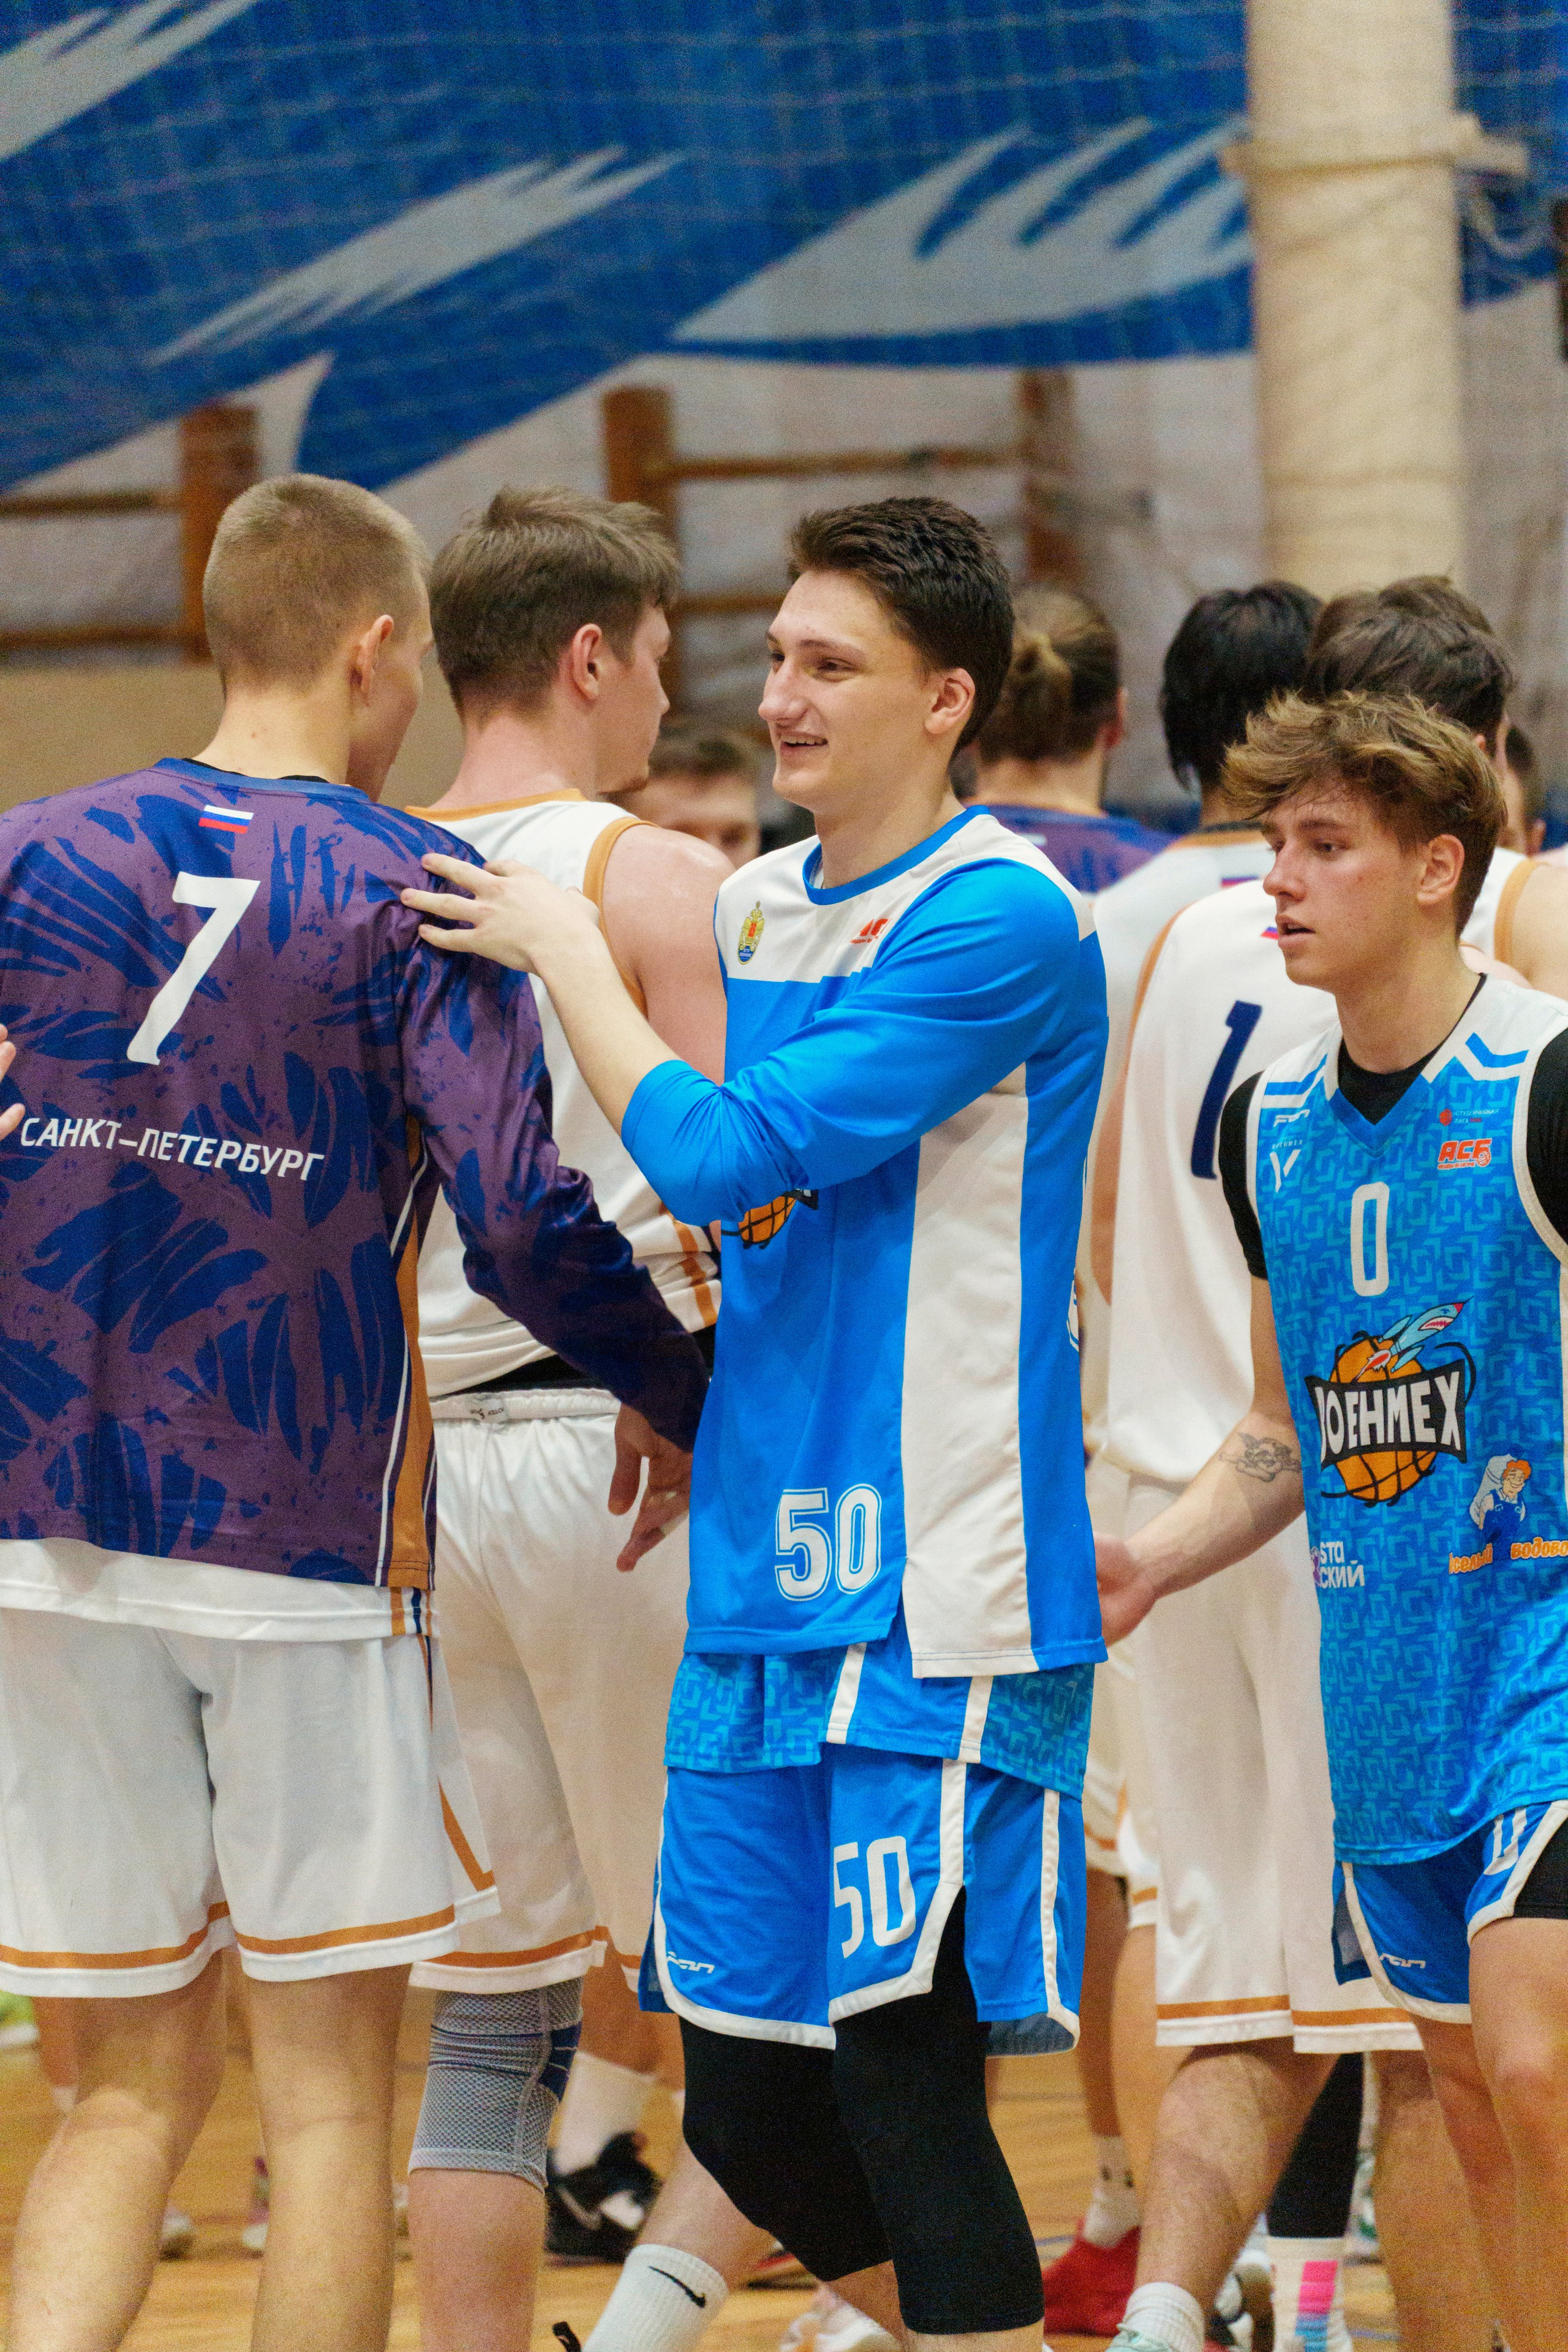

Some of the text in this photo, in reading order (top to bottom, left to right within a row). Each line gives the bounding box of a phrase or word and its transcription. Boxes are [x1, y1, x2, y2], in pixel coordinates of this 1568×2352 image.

[127, 871, 261, 1066] 7
[20, 1118, 325, 1182] САНКТ-ПЕТЕРБУРГ
[1438, 1138, 1493, 1167] АСБ
[1350, 1182, 1390, 1297] 0
[774, 1483, 882, 1602] 50
[833, 1836, 917, 1959] 50
